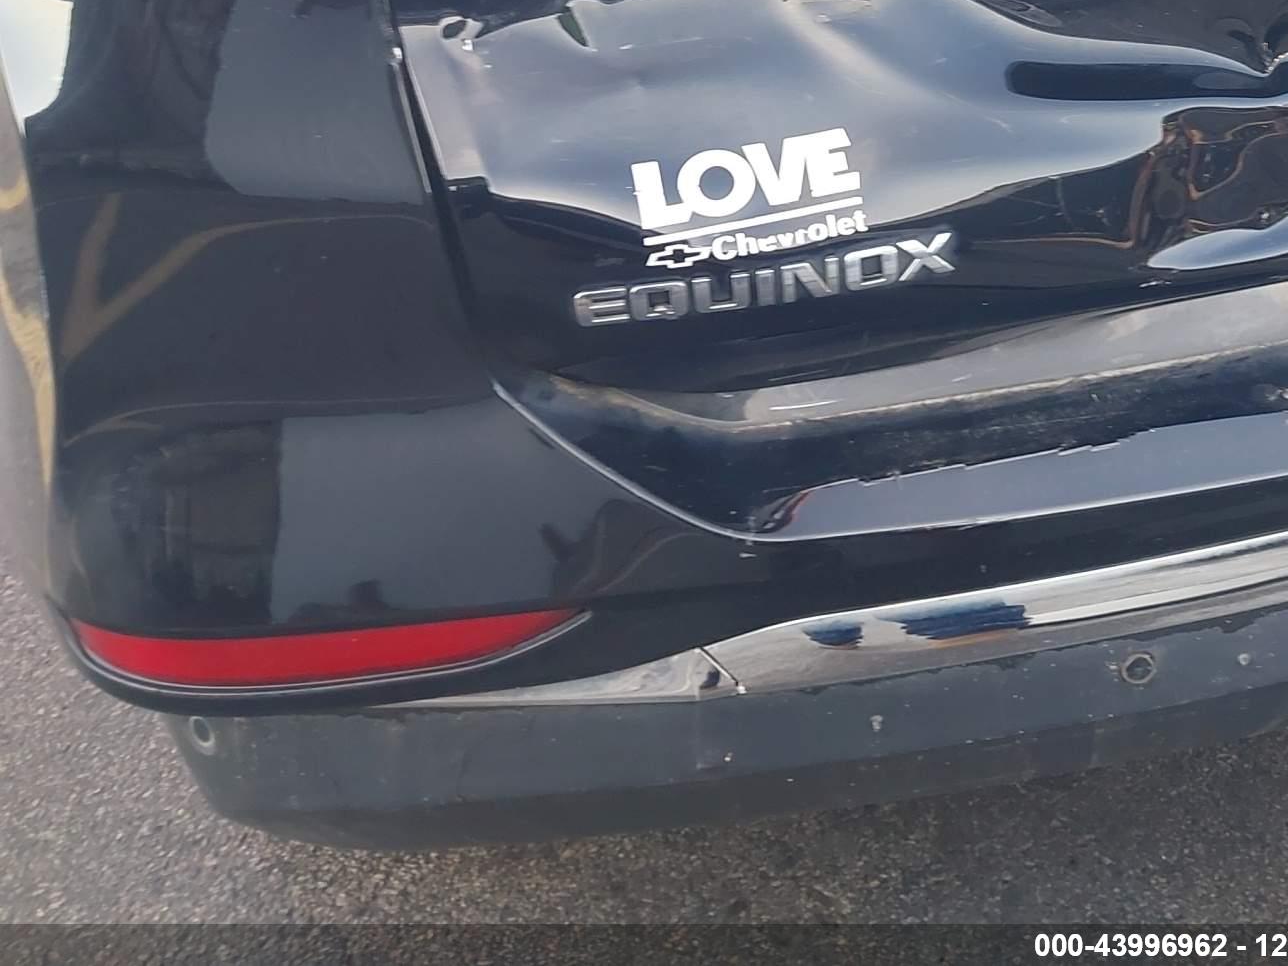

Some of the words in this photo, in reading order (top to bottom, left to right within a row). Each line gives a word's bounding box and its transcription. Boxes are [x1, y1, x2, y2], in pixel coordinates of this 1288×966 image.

[630, 127, 862, 230] LOVE
[572, 231, 956, 328] EQUINOX
[711, 209, 870, 262] Chevrolet
